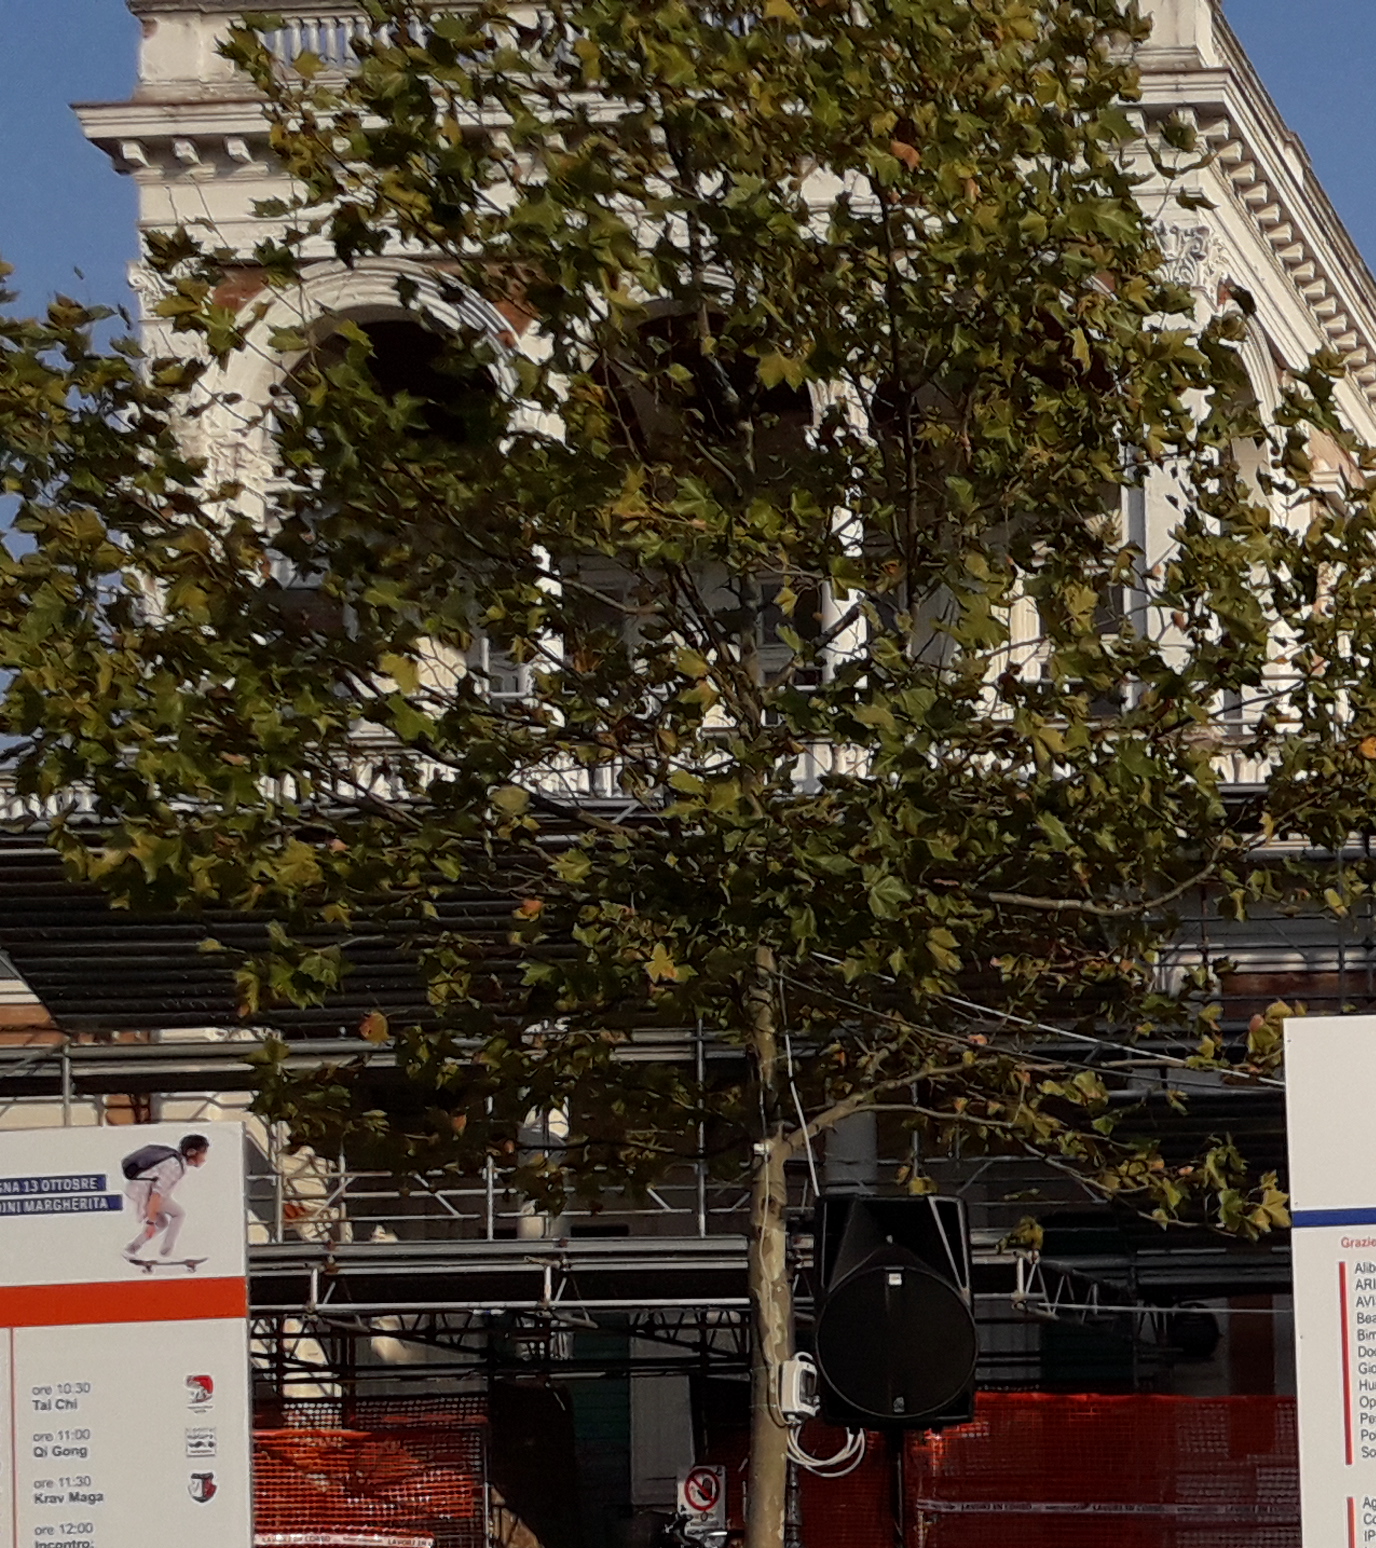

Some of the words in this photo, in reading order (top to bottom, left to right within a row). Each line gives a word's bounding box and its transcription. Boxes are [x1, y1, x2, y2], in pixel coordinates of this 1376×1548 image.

[23, 1180, 39, 1193] 13
[23, 1197, 109, 1213] MARGHERITA
[1341, 1237, 1376, 1249] Grazie
[32, 1386, 53, 1396] ore
[32, 1399, 52, 1411] Tai
[55, 1398, 78, 1411] Chi
[33, 1432, 54, 1442] ore
[58, 1429, 91, 1441] 11:00
[33, 1446, 48, 1458] Qi
[52, 1446, 88, 1458] Gong
[34, 1480, 54, 1489] ore
[59, 1476, 91, 1488] 11:30
[34, 1493, 64, 1504] Krav
[69, 1492, 104, 1505] Maga
[35, 1526, 54, 1536] ore
[59, 1522, 94, 1535] 12:00
